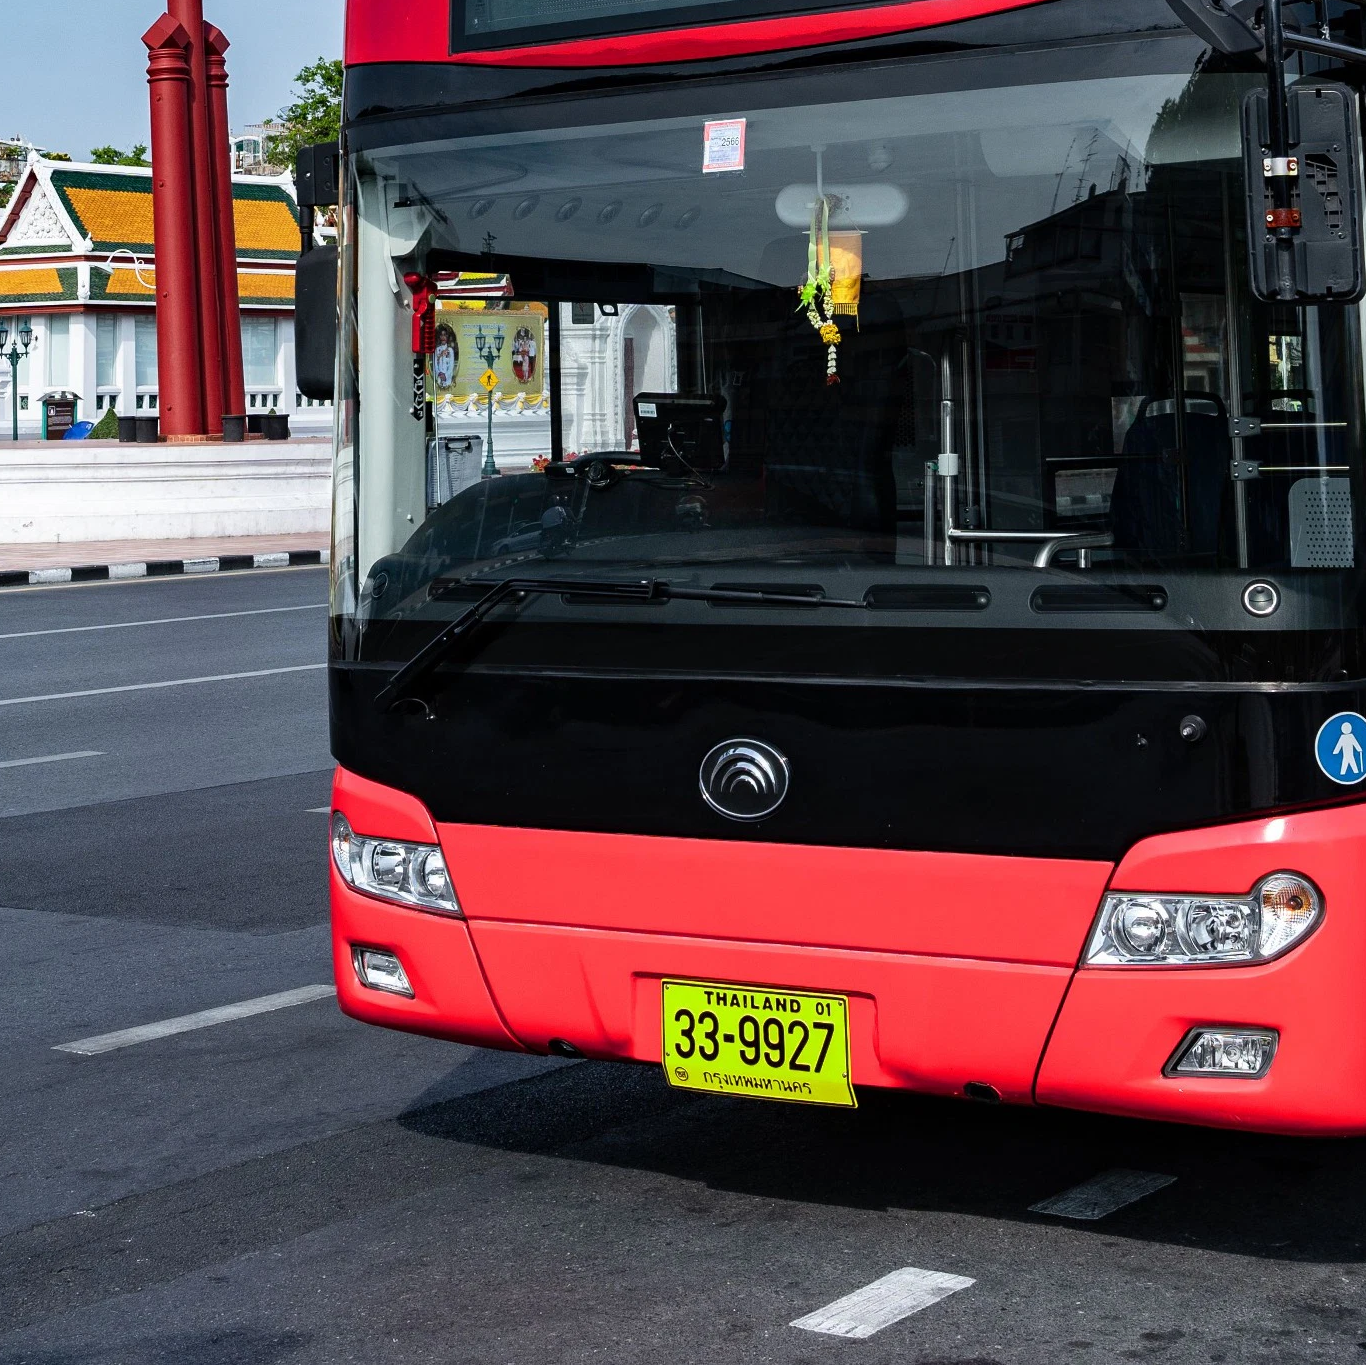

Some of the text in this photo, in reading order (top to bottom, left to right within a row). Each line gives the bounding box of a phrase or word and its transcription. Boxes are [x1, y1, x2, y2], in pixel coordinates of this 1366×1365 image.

[721, 137, 739, 147] 2566
[703, 990, 832, 1017] THAILAND 01
[674, 1008, 835, 1073] 33-9927
[703, 1069, 813, 1095] กรุงเทพมหานคร
